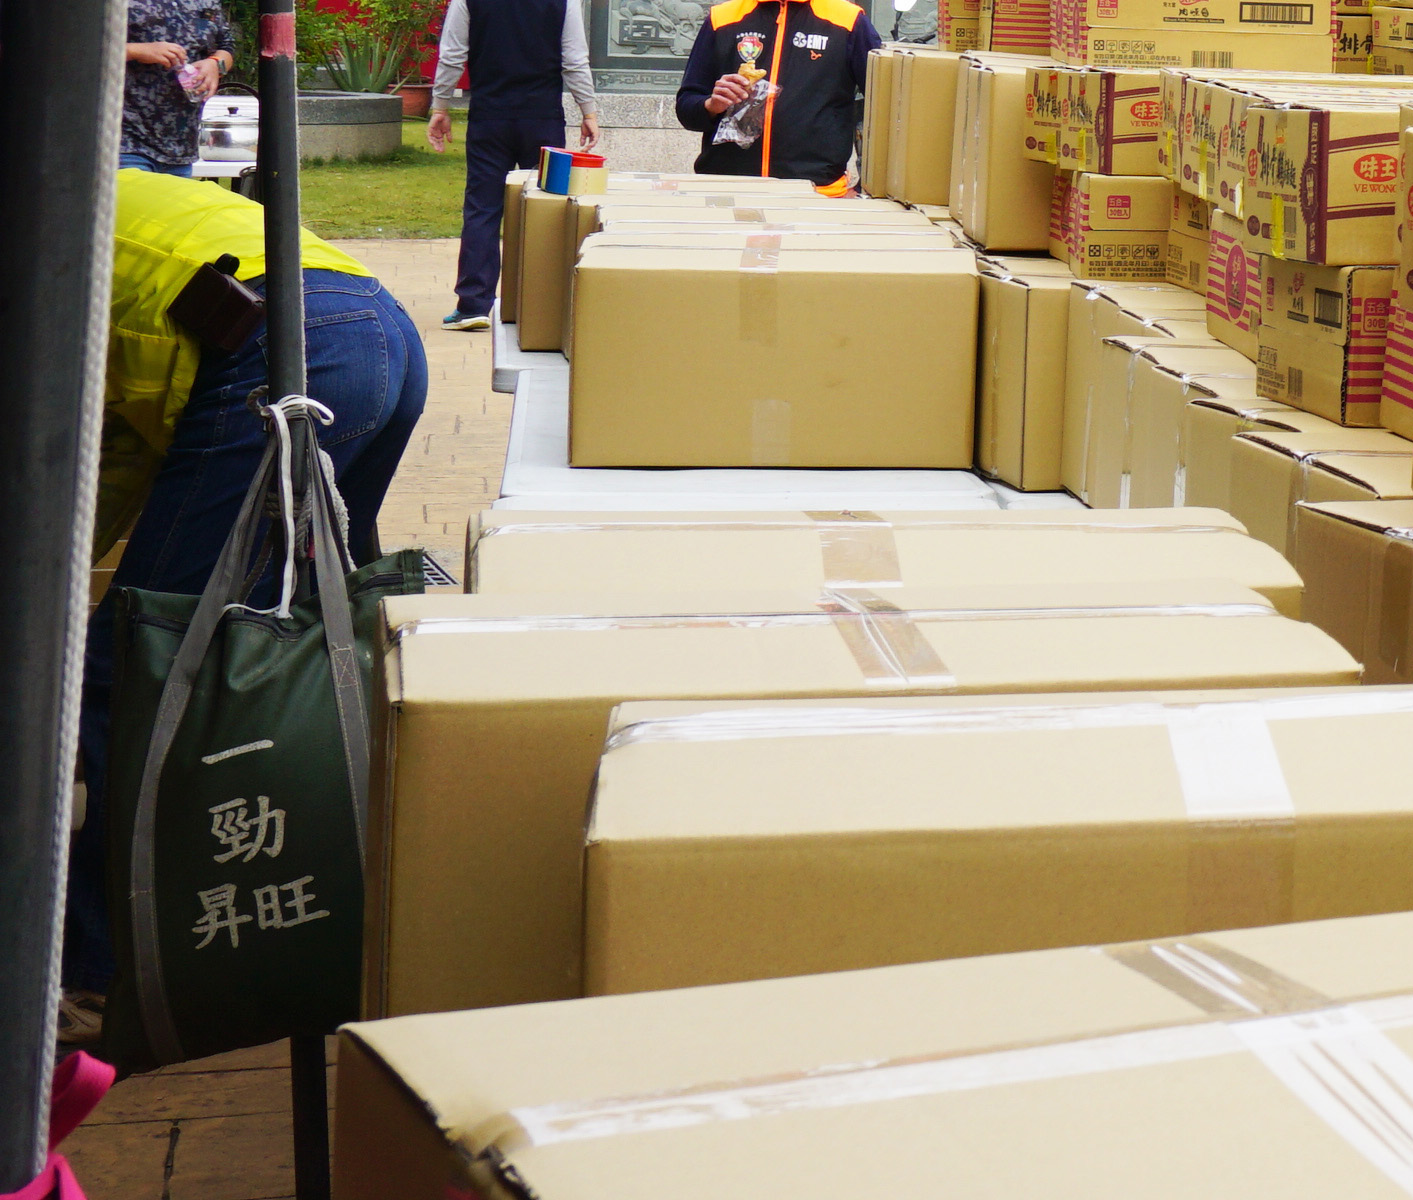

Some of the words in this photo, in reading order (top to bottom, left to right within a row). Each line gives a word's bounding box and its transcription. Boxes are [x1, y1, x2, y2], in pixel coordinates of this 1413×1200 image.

[806, 36, 829, 50] EMT
[210, 794, 288, 865] 勁
[191, 874, 331, 951] 昇旺
